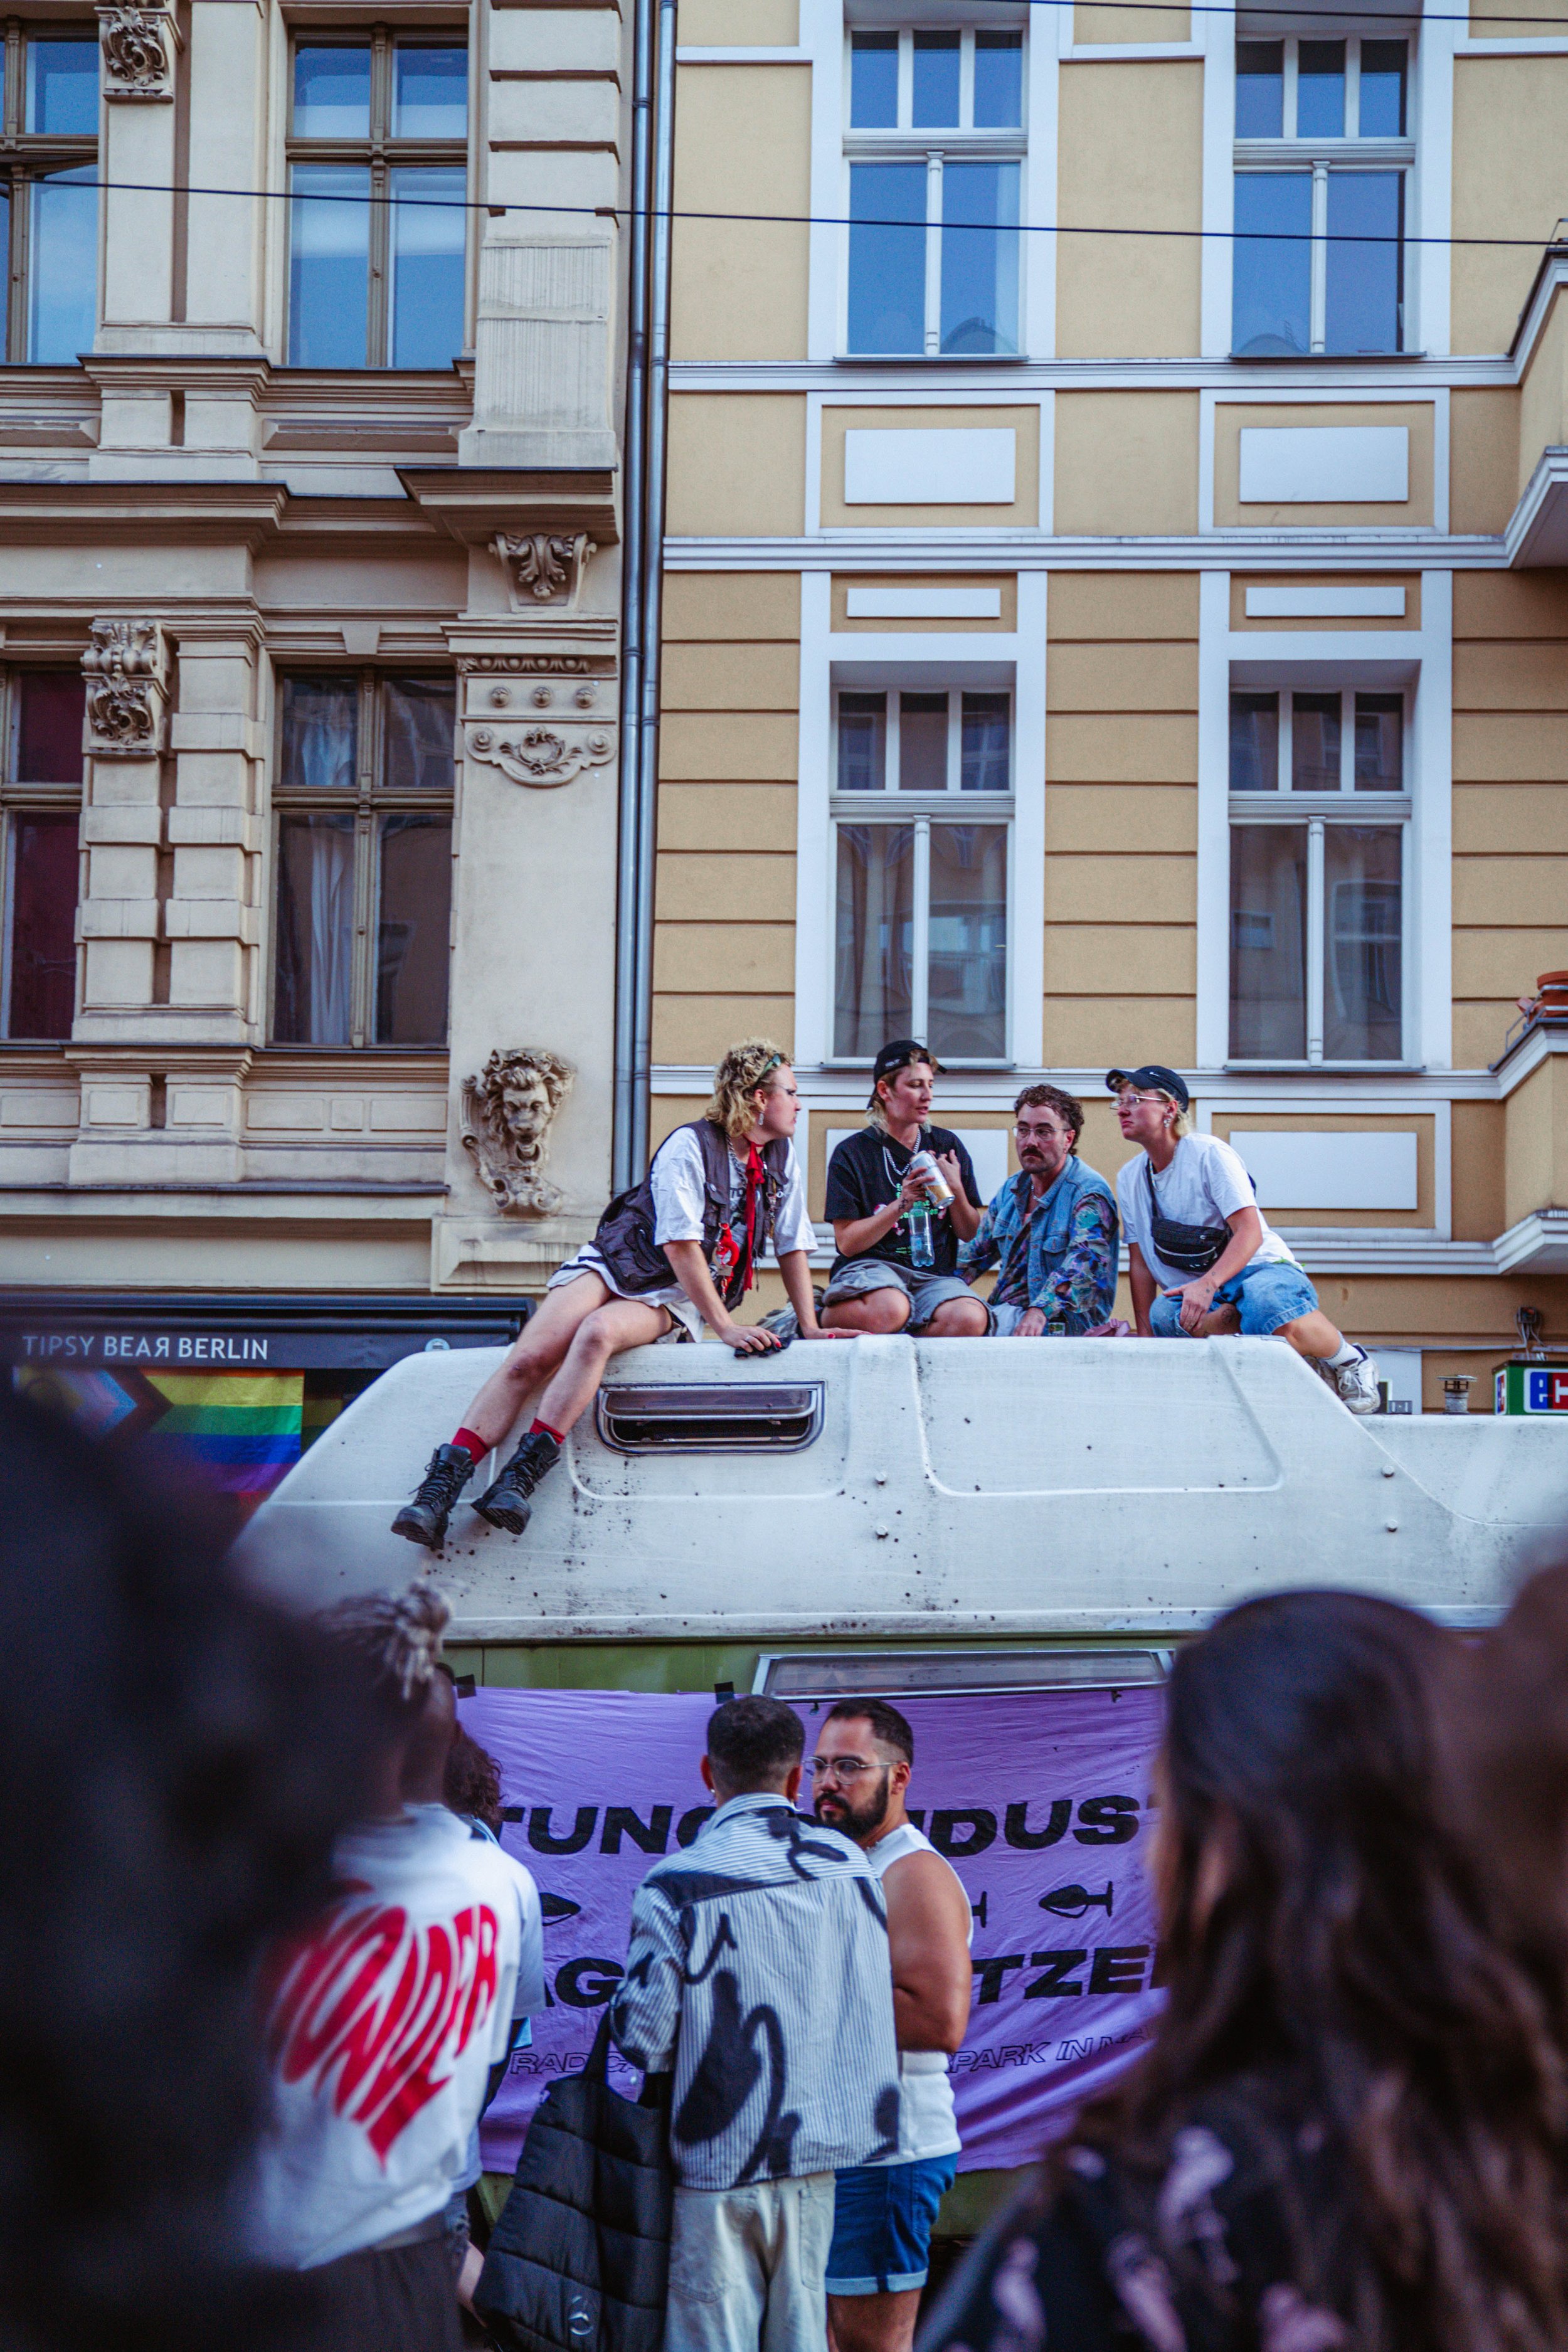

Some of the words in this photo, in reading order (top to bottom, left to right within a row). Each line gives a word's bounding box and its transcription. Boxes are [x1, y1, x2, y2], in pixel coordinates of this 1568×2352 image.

[22, 1335, 95, 1357] TIPSY
[178, 1338, 268, 1360] BERLIN
[943, 2041, 1051, 2074] PARK
[1056, 2037, 1093, 2061] IN
